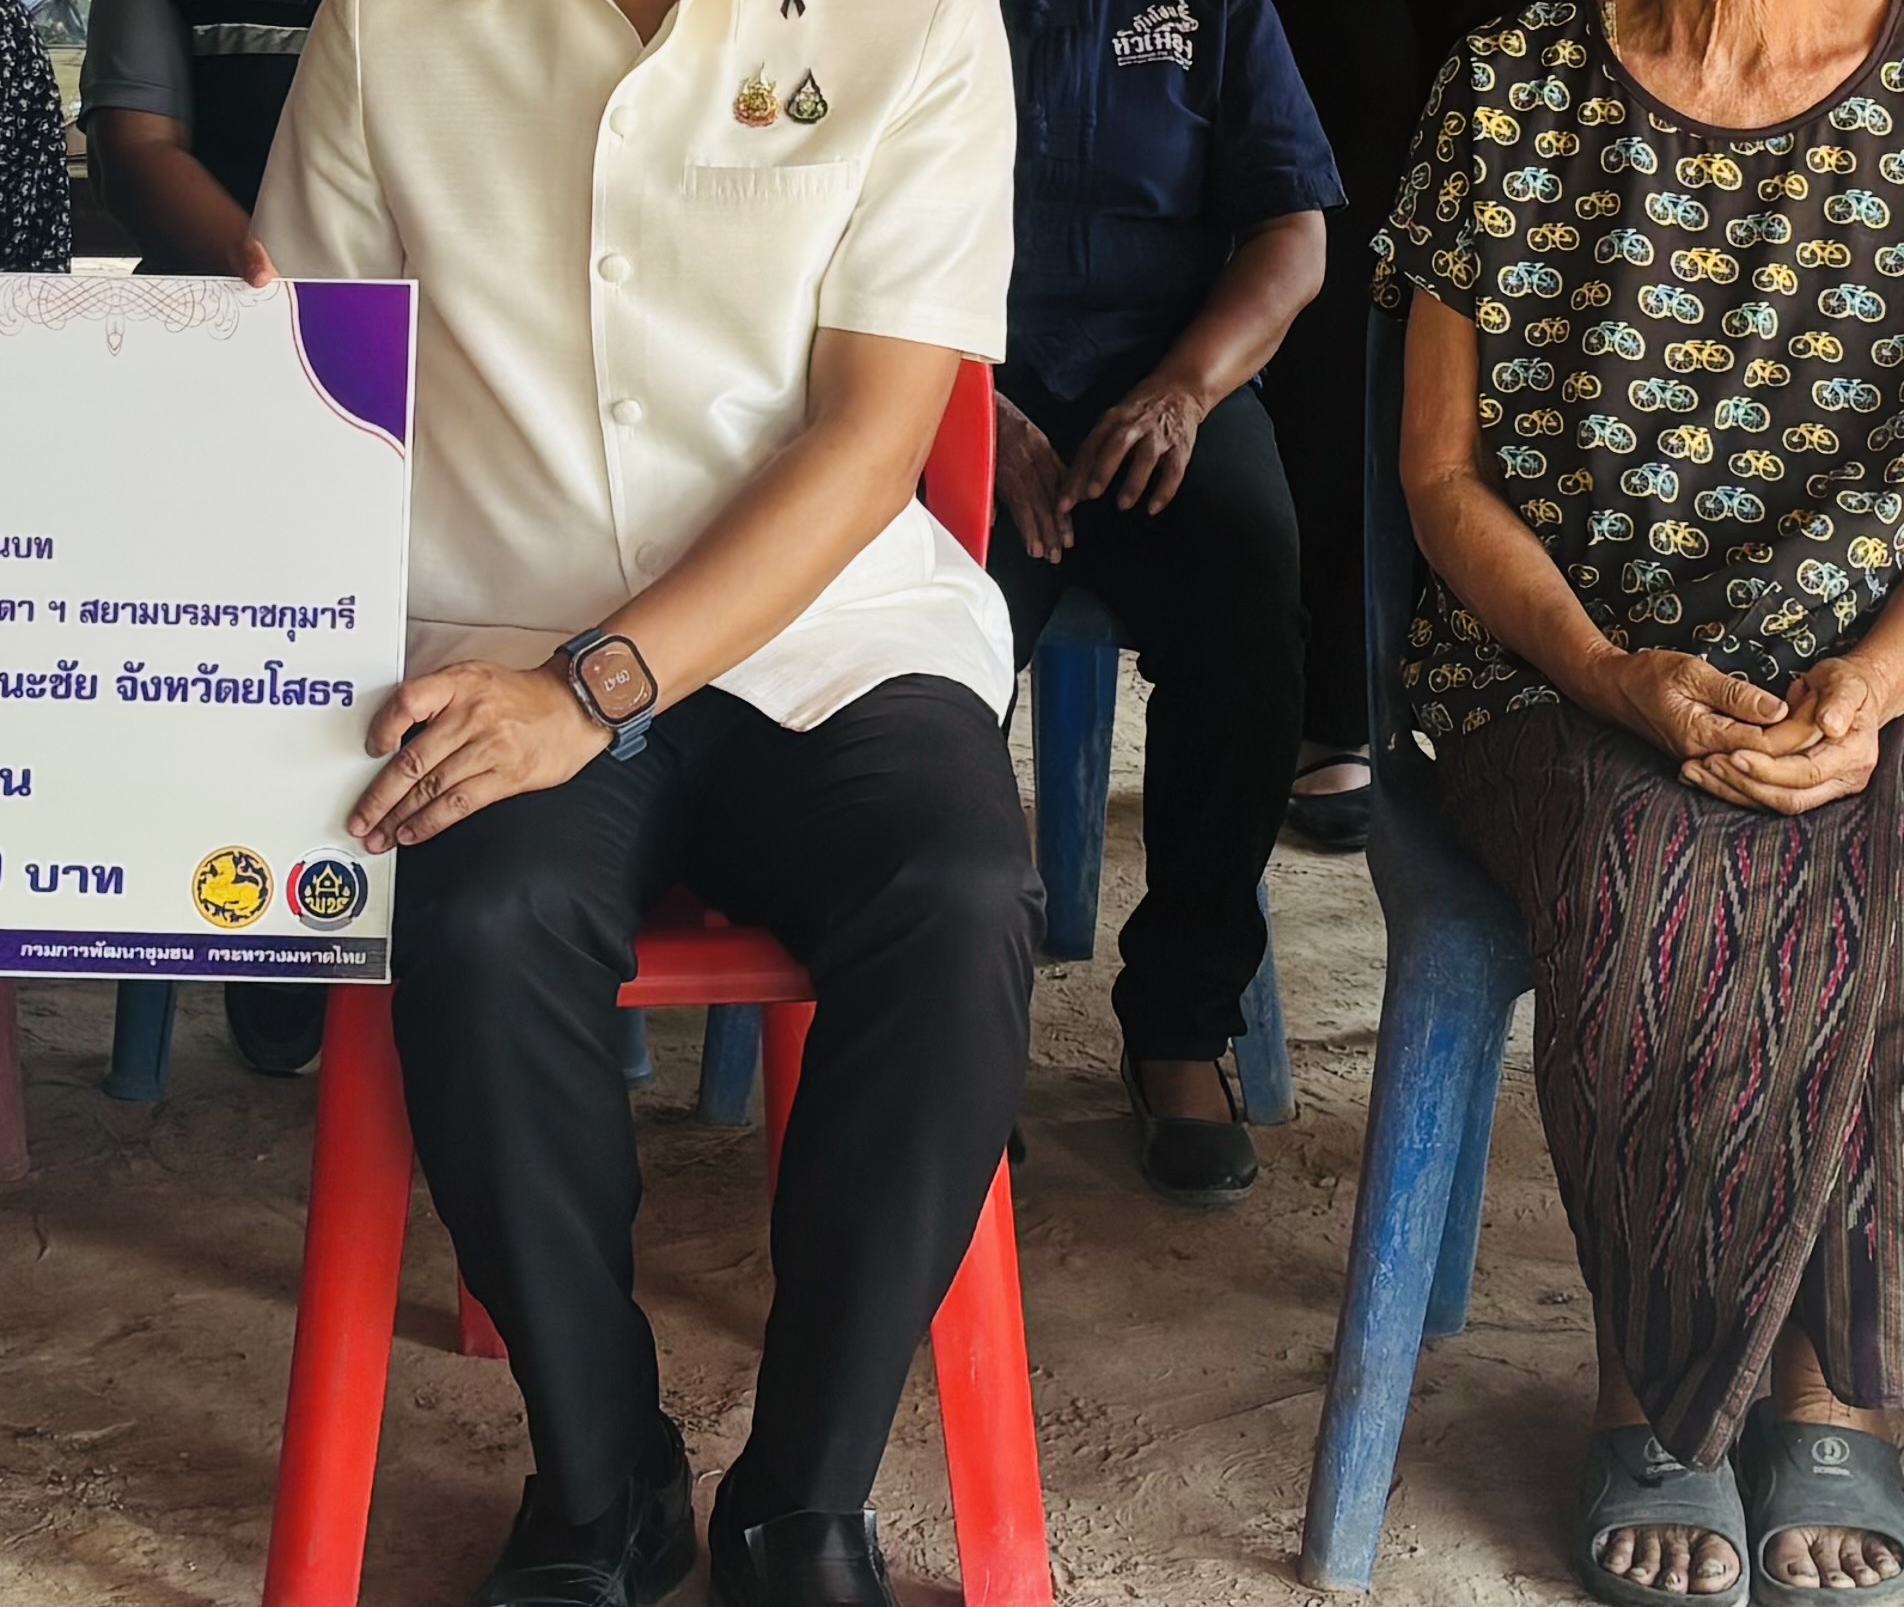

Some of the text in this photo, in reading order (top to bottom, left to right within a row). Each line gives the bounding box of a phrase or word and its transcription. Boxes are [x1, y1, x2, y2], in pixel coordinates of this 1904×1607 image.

[79, 596, 357, 642] สยามบรมราชกุมารี
[115, 660, 355, 708] จังหวัดยโสธร
[24, 863, 125, 895] บาท
[20, 940, 368, 967] กรมการพัฒนาชุมชน กระทรวงมหาดไทย
